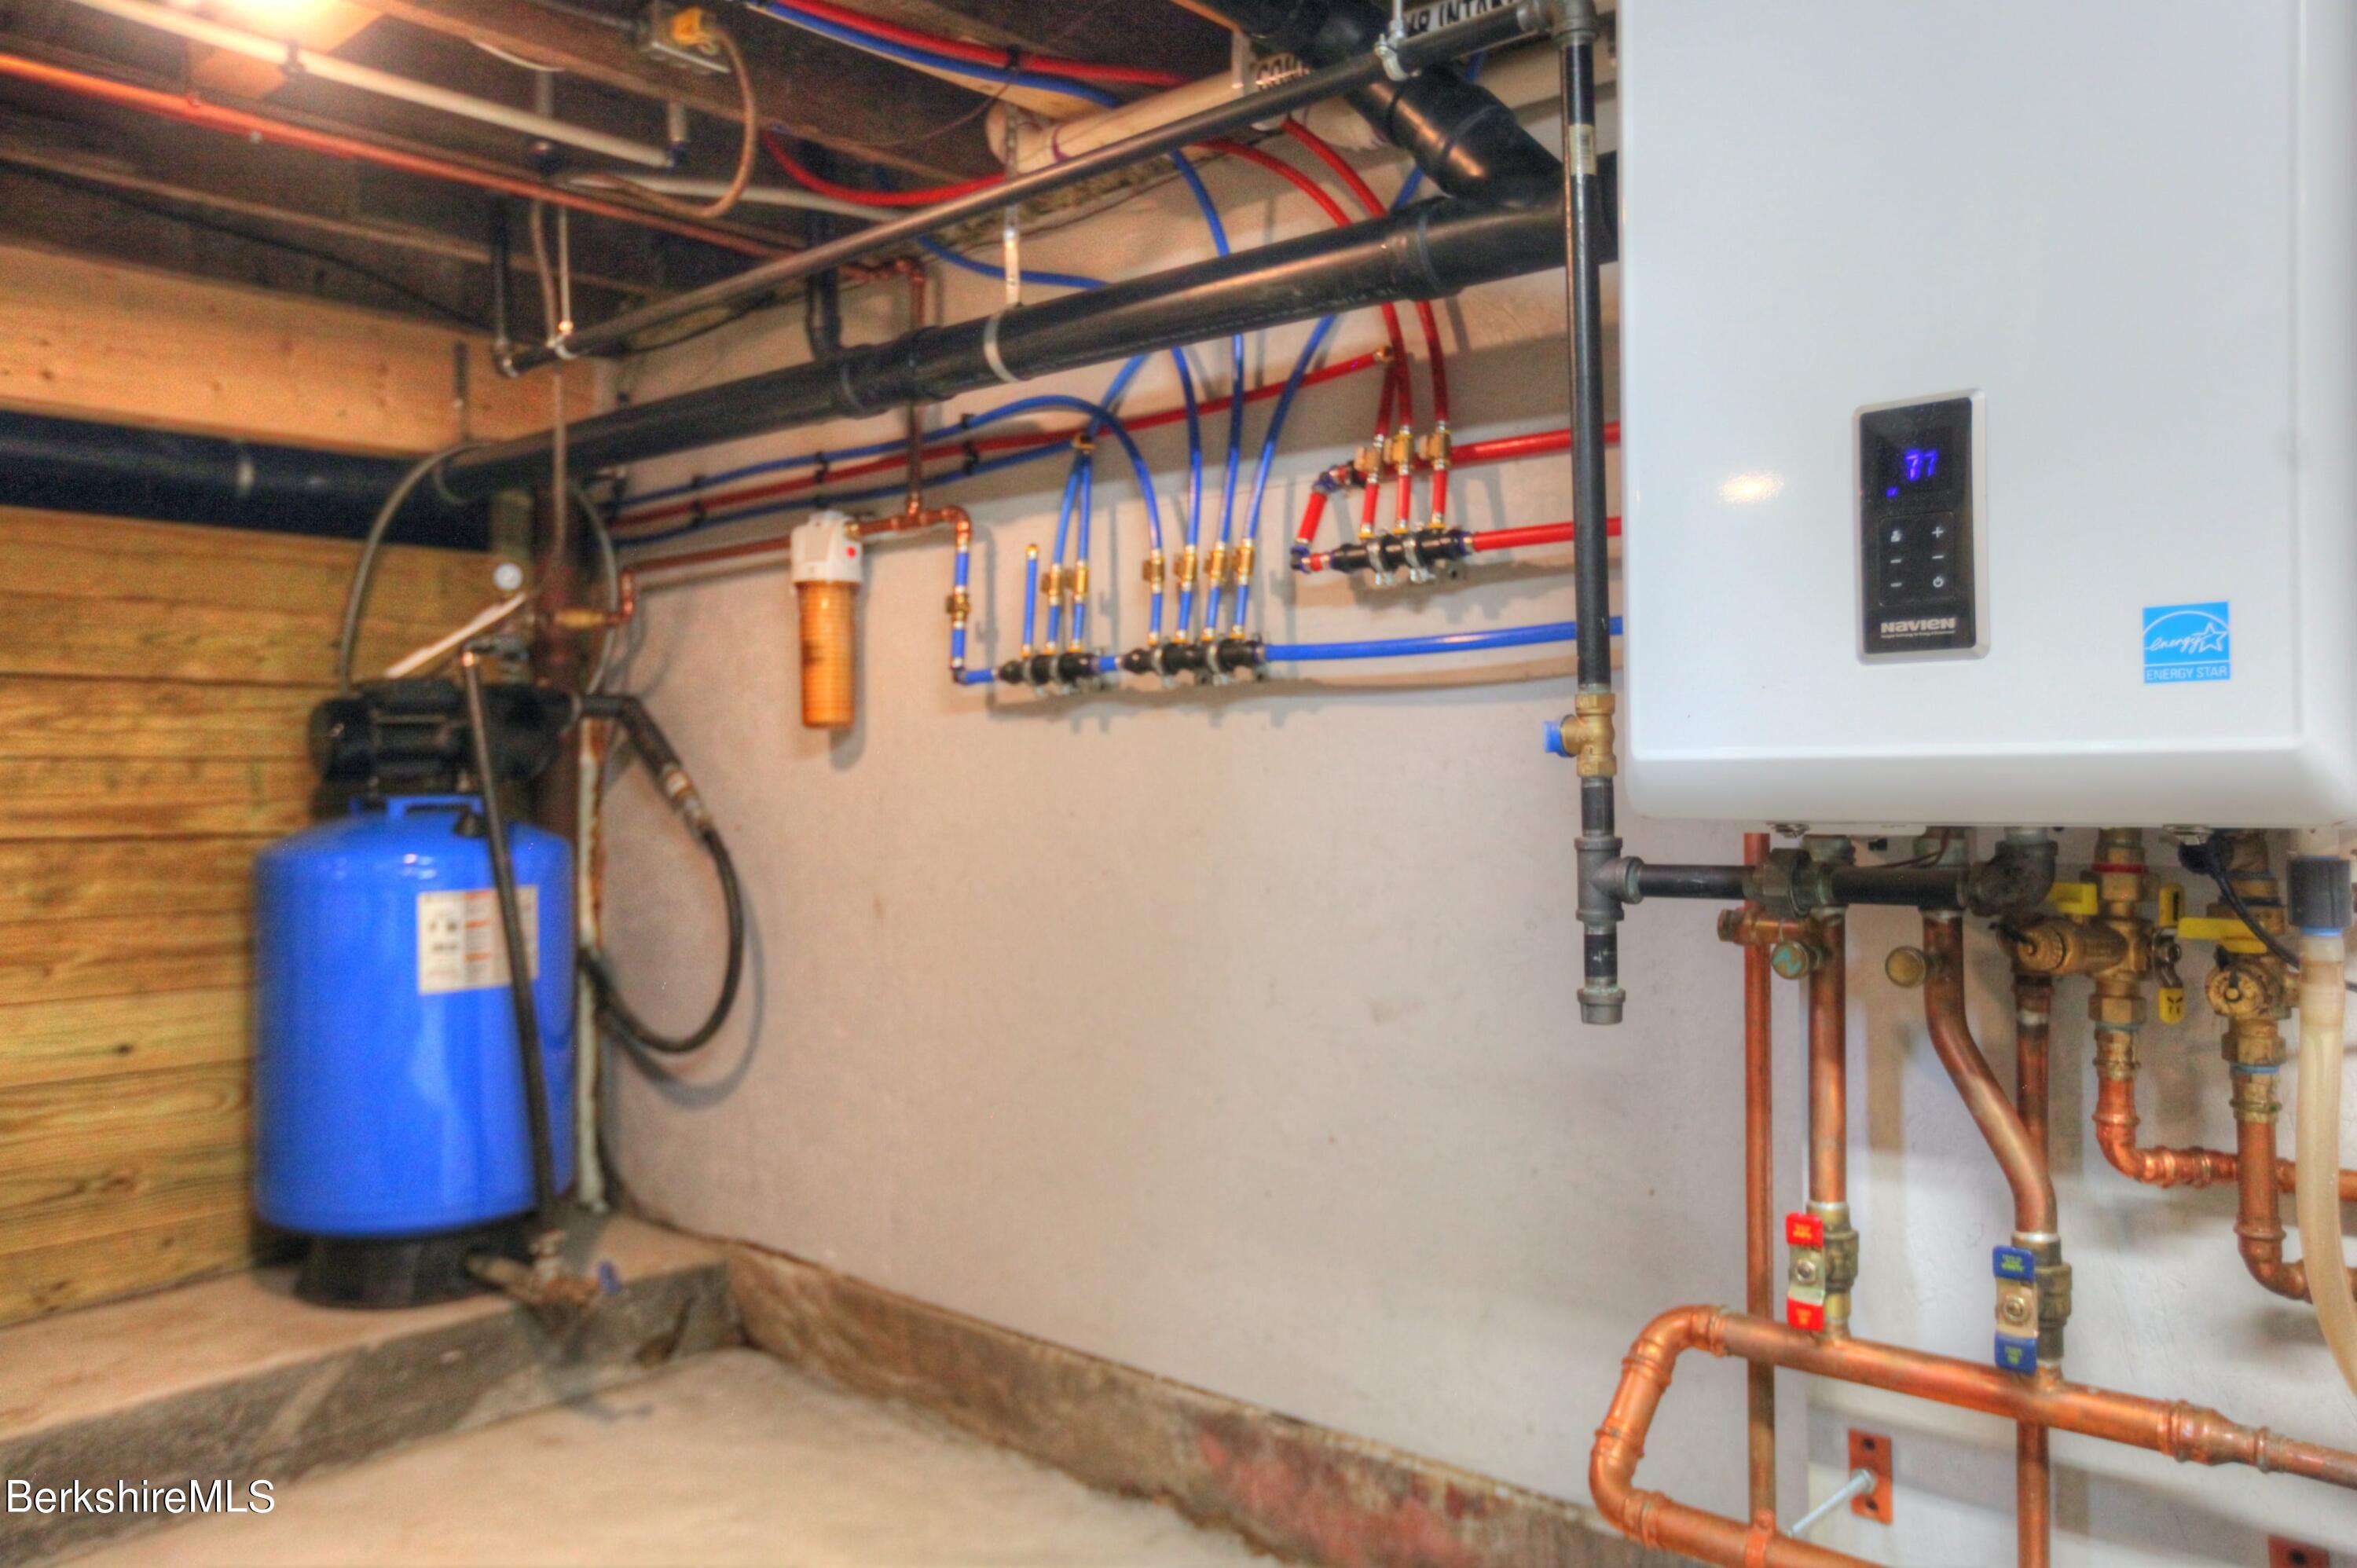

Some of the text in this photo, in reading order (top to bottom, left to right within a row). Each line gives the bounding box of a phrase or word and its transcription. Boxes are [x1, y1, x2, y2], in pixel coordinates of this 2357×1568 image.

[1904, 448, 1939, 481] 77
[2146, 665, 2227, 681] ENERGY STAR
